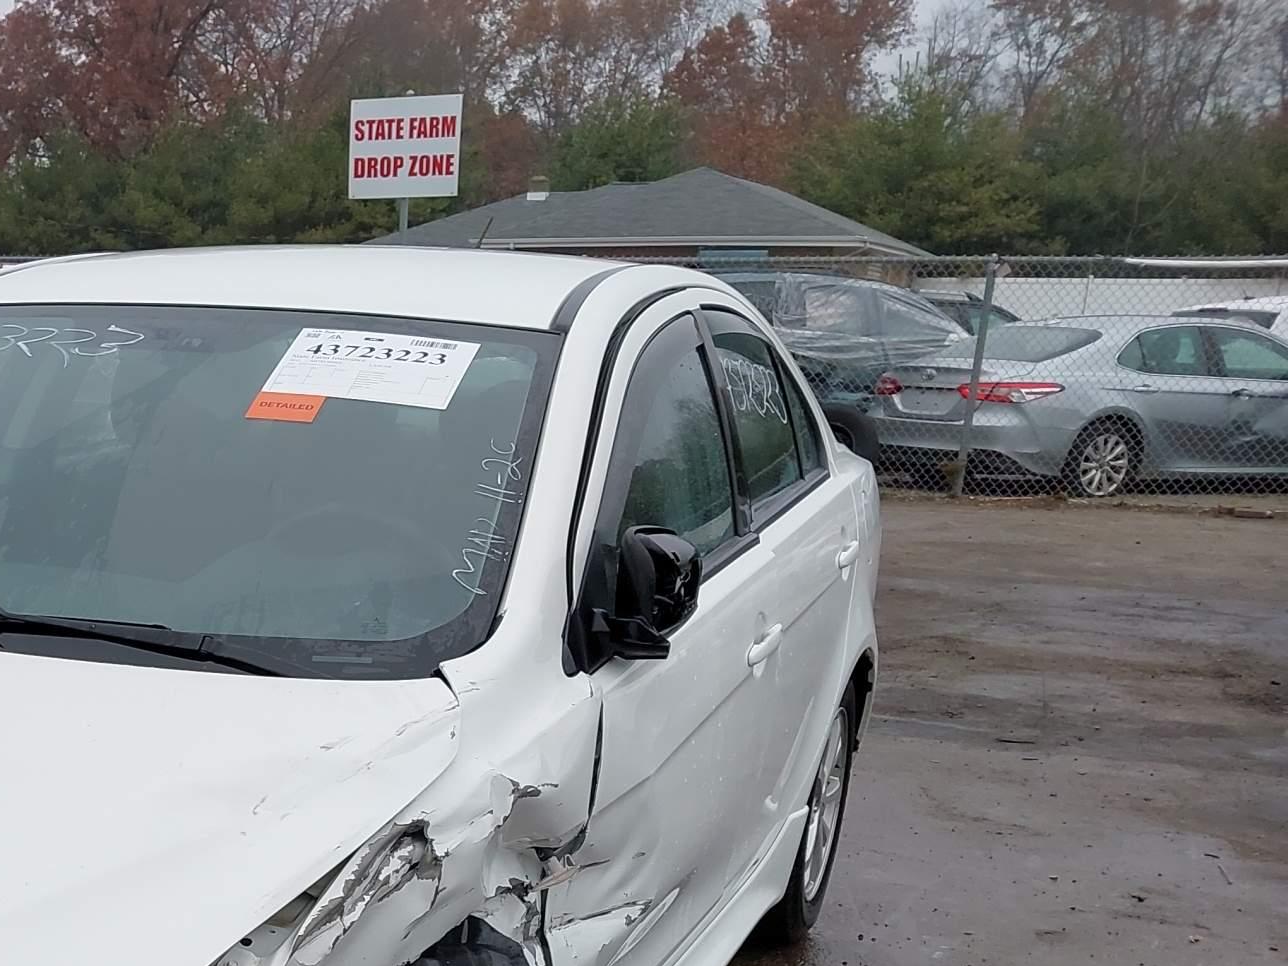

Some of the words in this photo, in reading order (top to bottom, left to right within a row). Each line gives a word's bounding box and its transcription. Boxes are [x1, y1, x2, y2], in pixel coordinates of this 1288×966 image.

[355, 118, 404, 141] STATE
[409, 116, 456, 139] FARM
[354, 156, 404, 178] DROP
[408, 154, 454, 177] ZONE
[306, 343, 447, 366] 43723223
[259, 401, 314, 411] DETAILED
